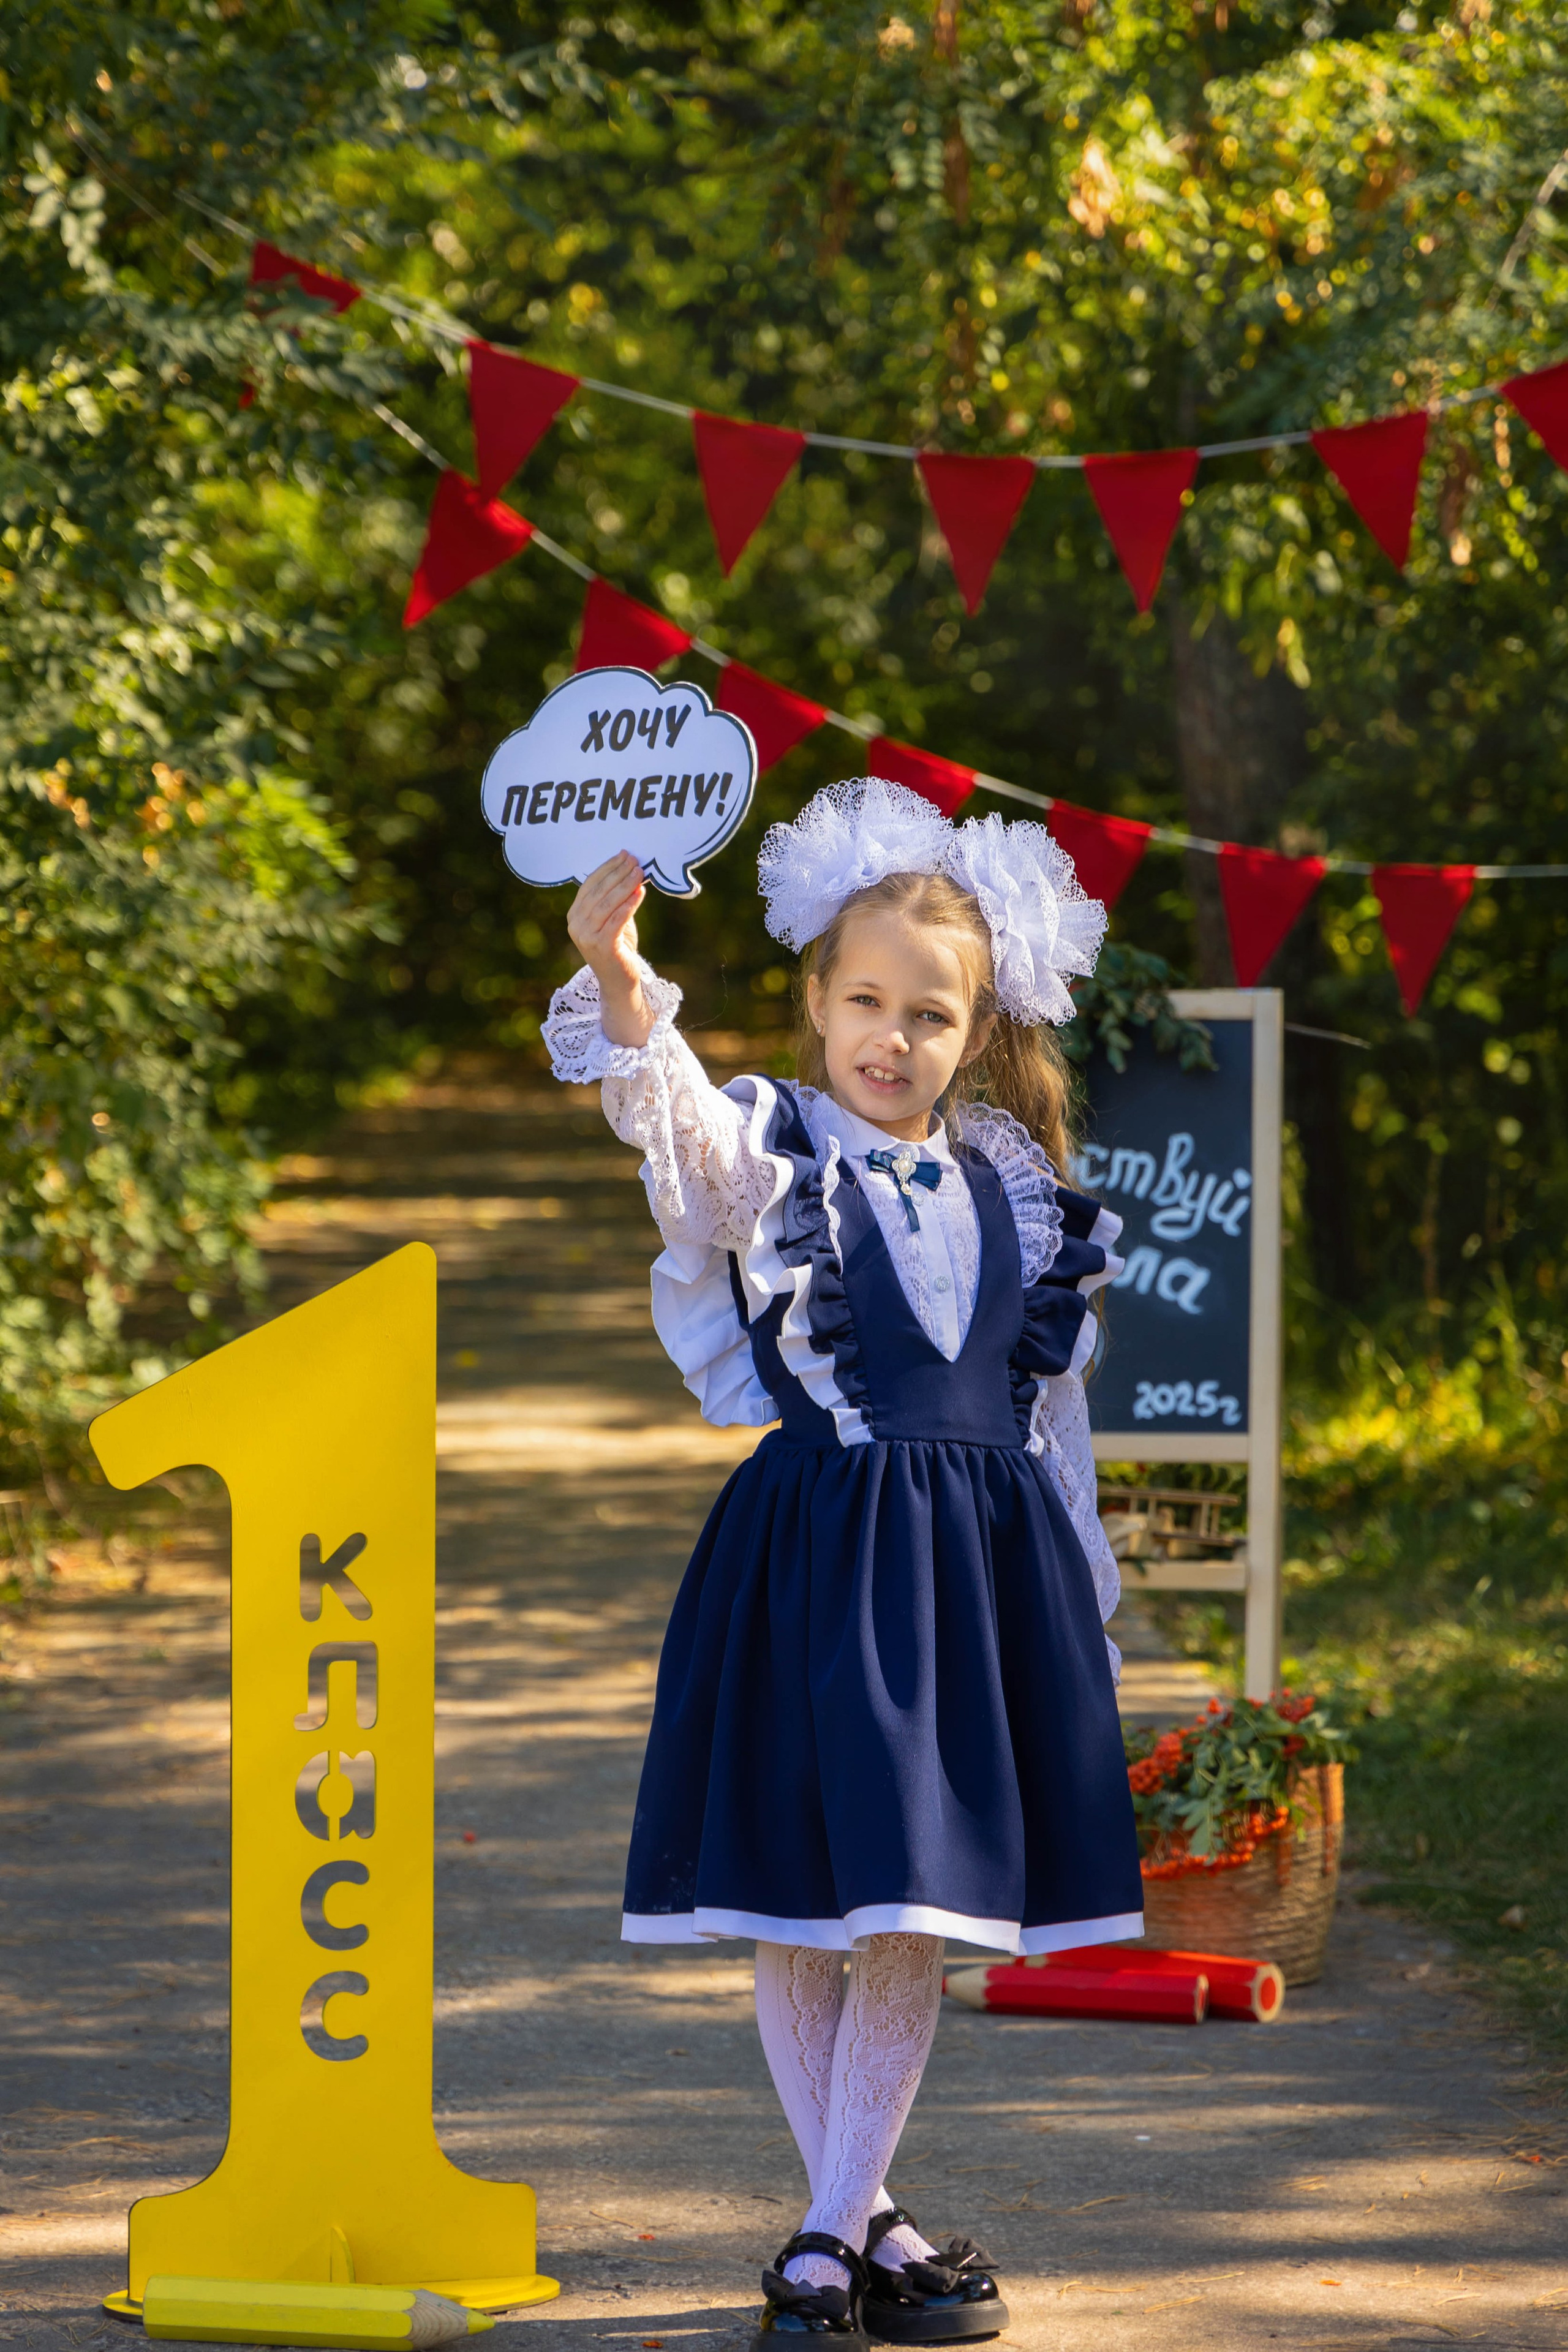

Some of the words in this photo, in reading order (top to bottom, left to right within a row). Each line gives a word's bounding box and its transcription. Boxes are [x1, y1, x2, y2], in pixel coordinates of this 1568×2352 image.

[580, 704, 692, 753] ХОЧУ
[500, 772, 733, 827] ПЕРЕМЕНУ!
[1066, 1132, 1252, 1242] ствуй
[1109, 1245, 1211, 1314] ла
